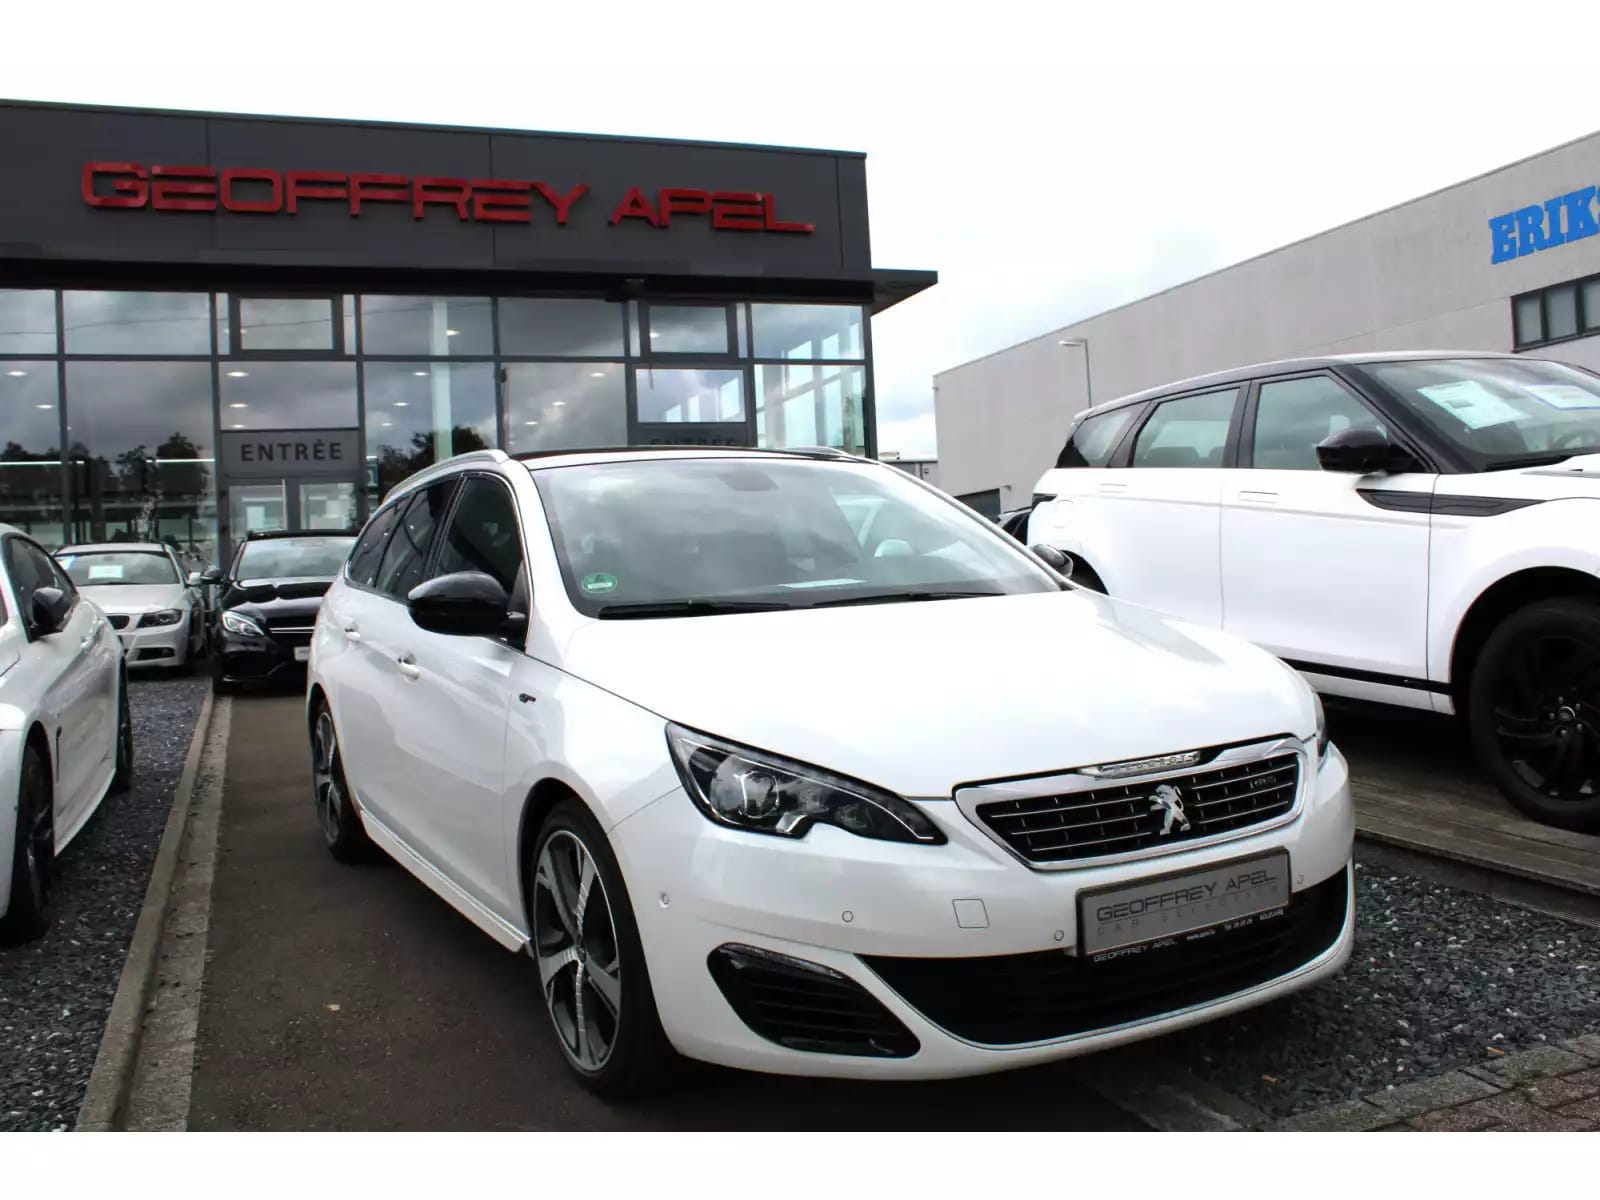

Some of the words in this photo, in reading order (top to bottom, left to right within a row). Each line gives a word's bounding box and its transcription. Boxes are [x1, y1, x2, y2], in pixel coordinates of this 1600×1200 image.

[82, 161, 590, 226] GEOFFREY
[608, 186, 816, 233] APEL
[1488, 184, 1600, 265] ERIK
[1096, 882, 1217, 922] GEOFFREY
[1226, 870, 1277, 891] APEL
